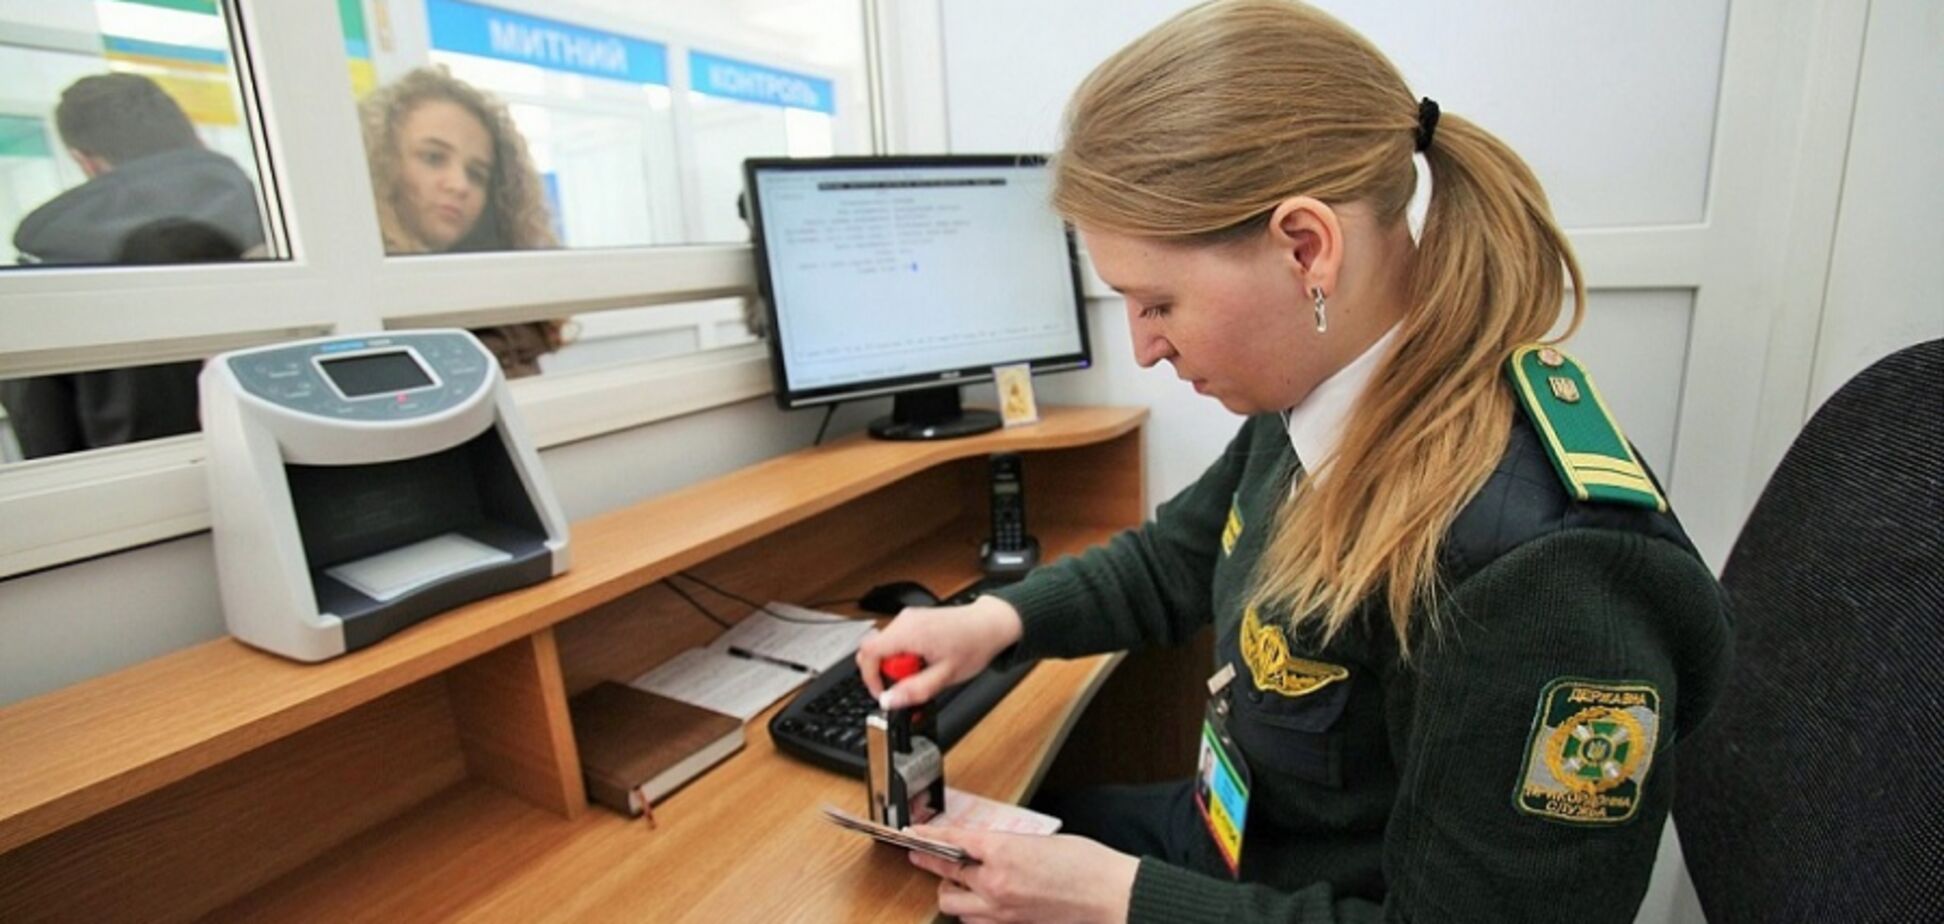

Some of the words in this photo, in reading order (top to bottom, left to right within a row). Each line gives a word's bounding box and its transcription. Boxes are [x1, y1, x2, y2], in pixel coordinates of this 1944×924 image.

[488, 19, 628, 73] МИТНИЙ
[709, 65, 819, 105] КОНТРОЛЬ
[1567, 688, 1646, 704] ДЕРЖАВНА
